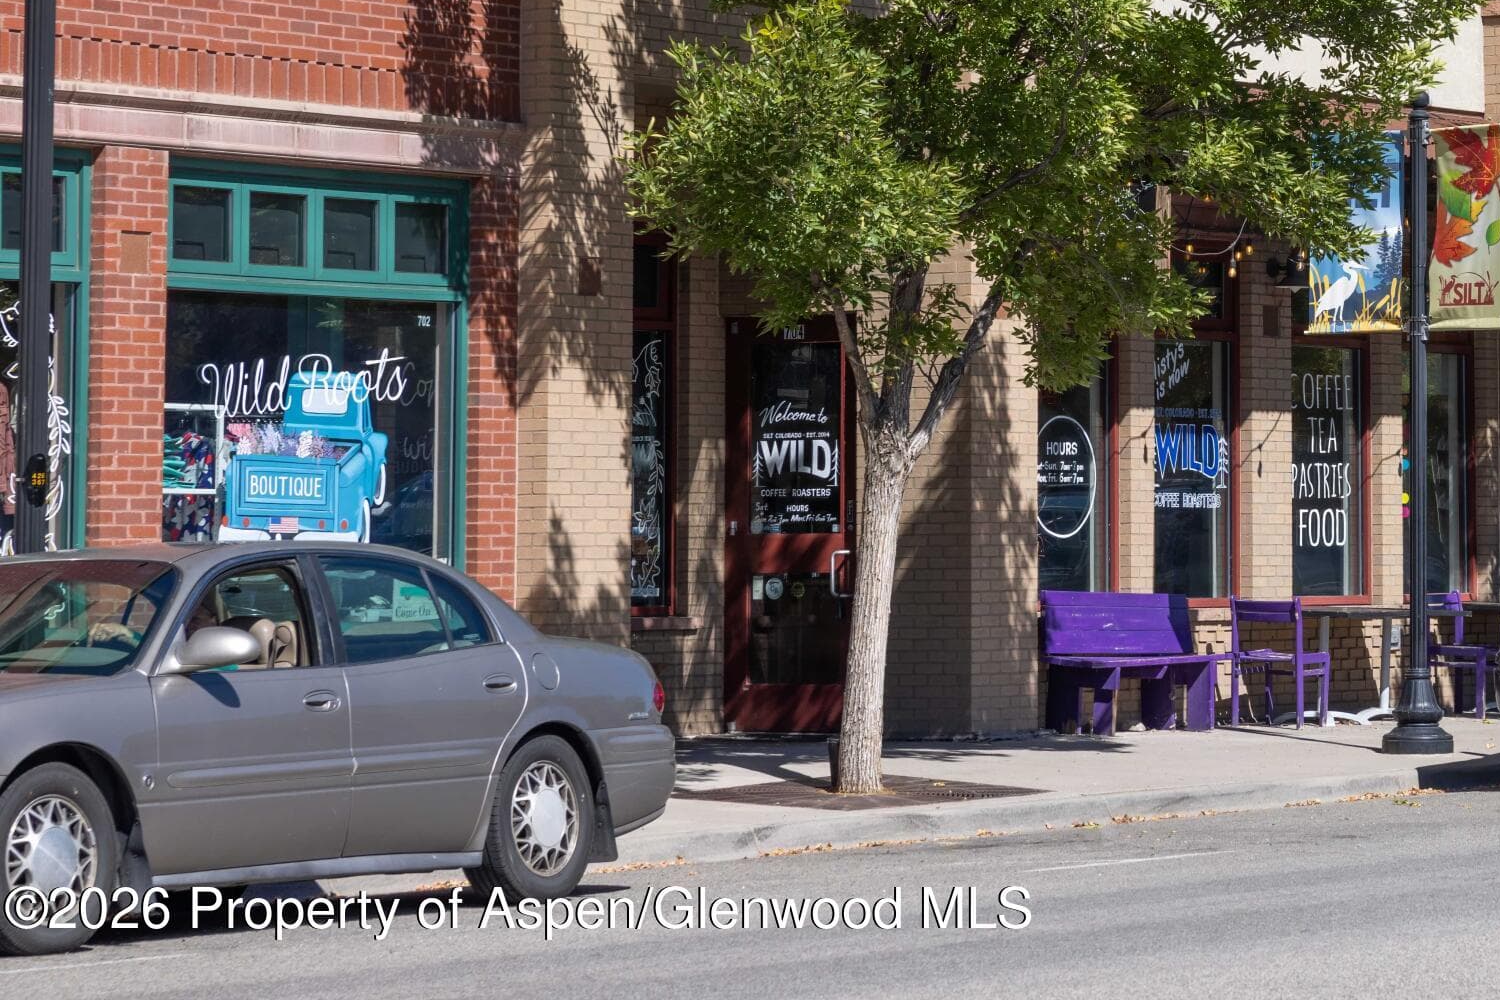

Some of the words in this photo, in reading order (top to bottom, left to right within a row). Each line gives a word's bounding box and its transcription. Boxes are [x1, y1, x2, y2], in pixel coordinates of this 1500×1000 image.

[1454, 282, 1486, 305] SILT
[416, 315, 431, 327] 702
[1154, 342, 1184, 380] isty's
[201, 355, 292, 419] Wild
[298, 348, 407, 408] Roots
[1156, 381, 1166, 401] is
[1169, 358, 1190, 390] now
[759, 400, 817, 428] Welcome
[818, 407, 828, 424] to
[1046, 441, 1079, 456] HOURS
[1154, 422, 1220, 480] WILD
[1306, 417, 1338, 454] TEA
[760, 439, 832, 479] WILD
[250, 474, 323, 498] BOUTIQUE
[760, 489, 787, 498] COFFEE
[792, 488, 832, 497] ROASTERS
[1292, 463, 1352, 499] PASTRIES
[786, 504, 809, 512] HOURS
[1182, 492, 1222, 509] ROASTERS
[1298, 508, 1347, 547] FOOD
